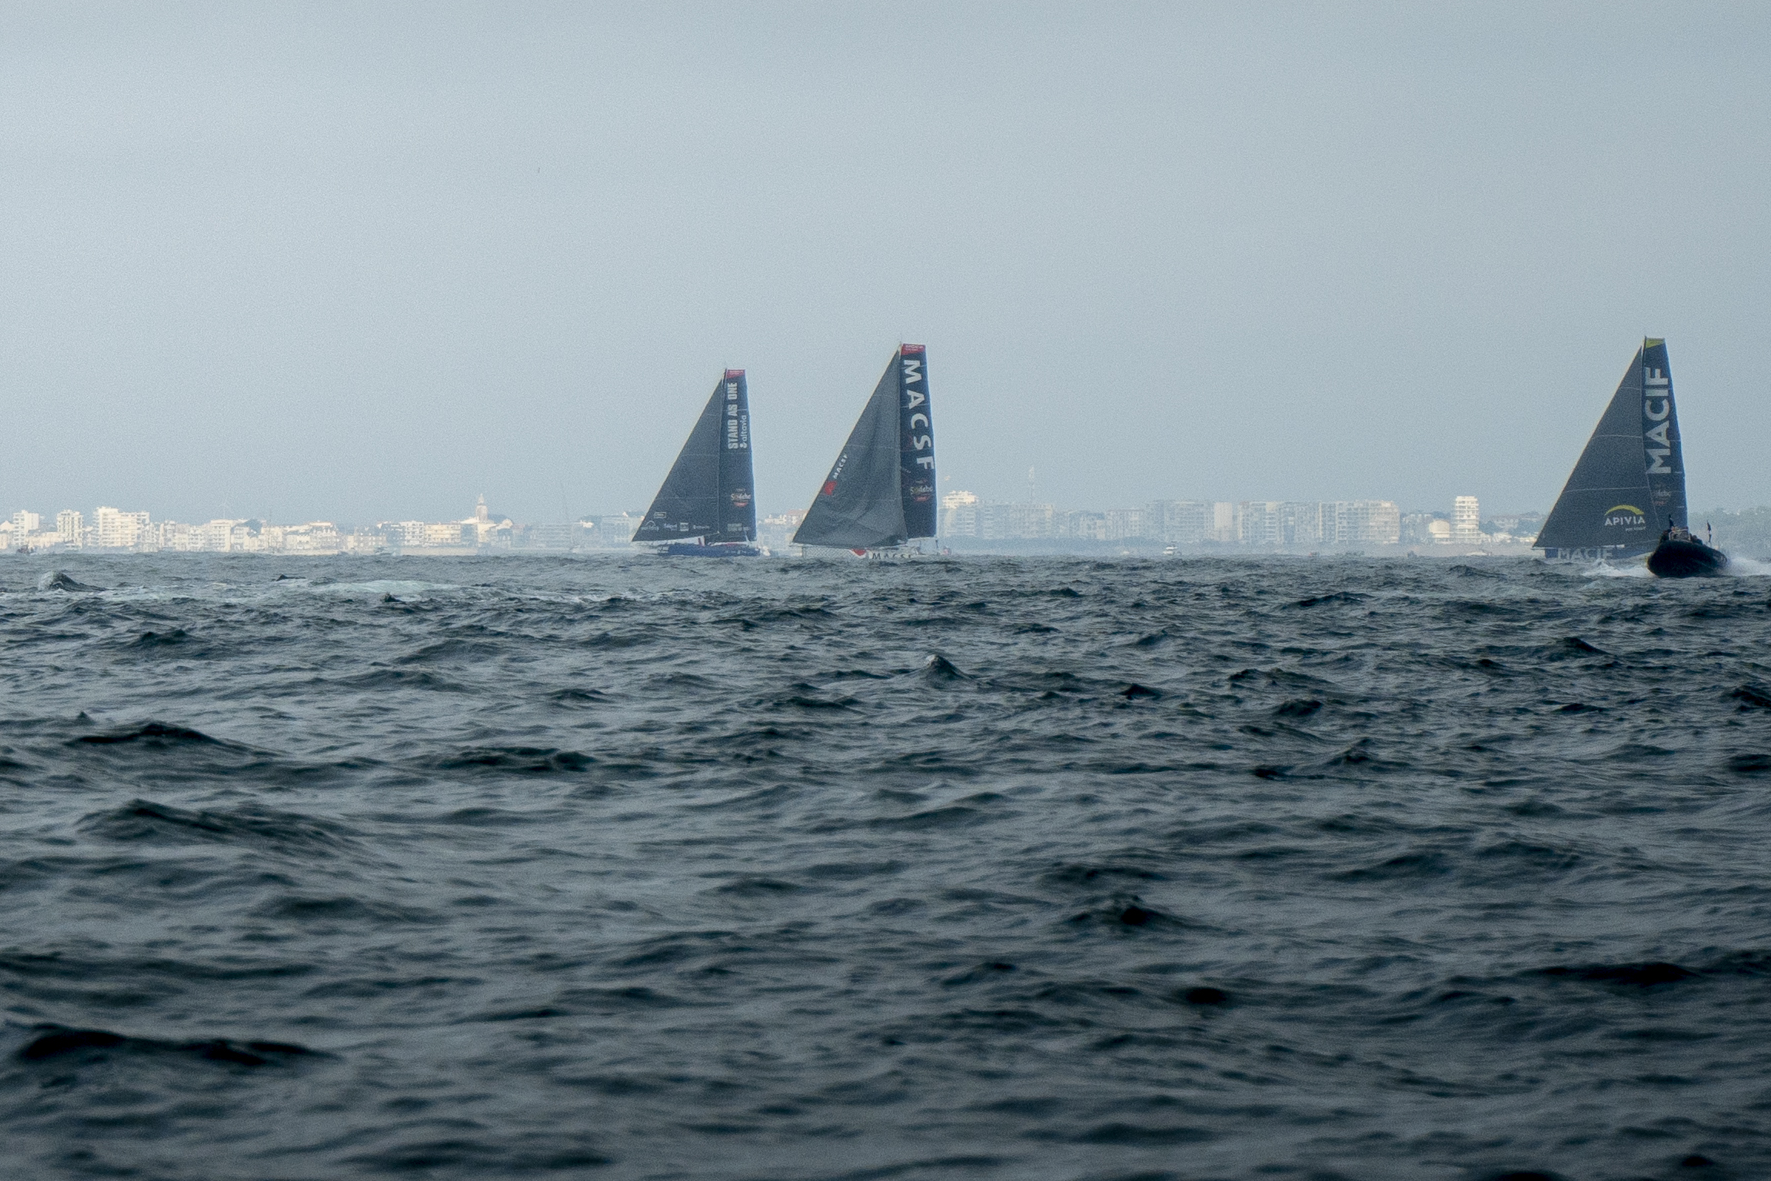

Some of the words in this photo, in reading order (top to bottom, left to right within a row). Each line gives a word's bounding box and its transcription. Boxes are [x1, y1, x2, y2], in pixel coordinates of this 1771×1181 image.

[727, 382, 738, 401] ONE
[727, 404, 738, 417] AS
[904, 359, 935, 470] MACSF
[1644, 366, 1672, 475] MACIF
[727, 419, 739, 450] STAND
[1604, 515, 1646, 526] APIVIA
